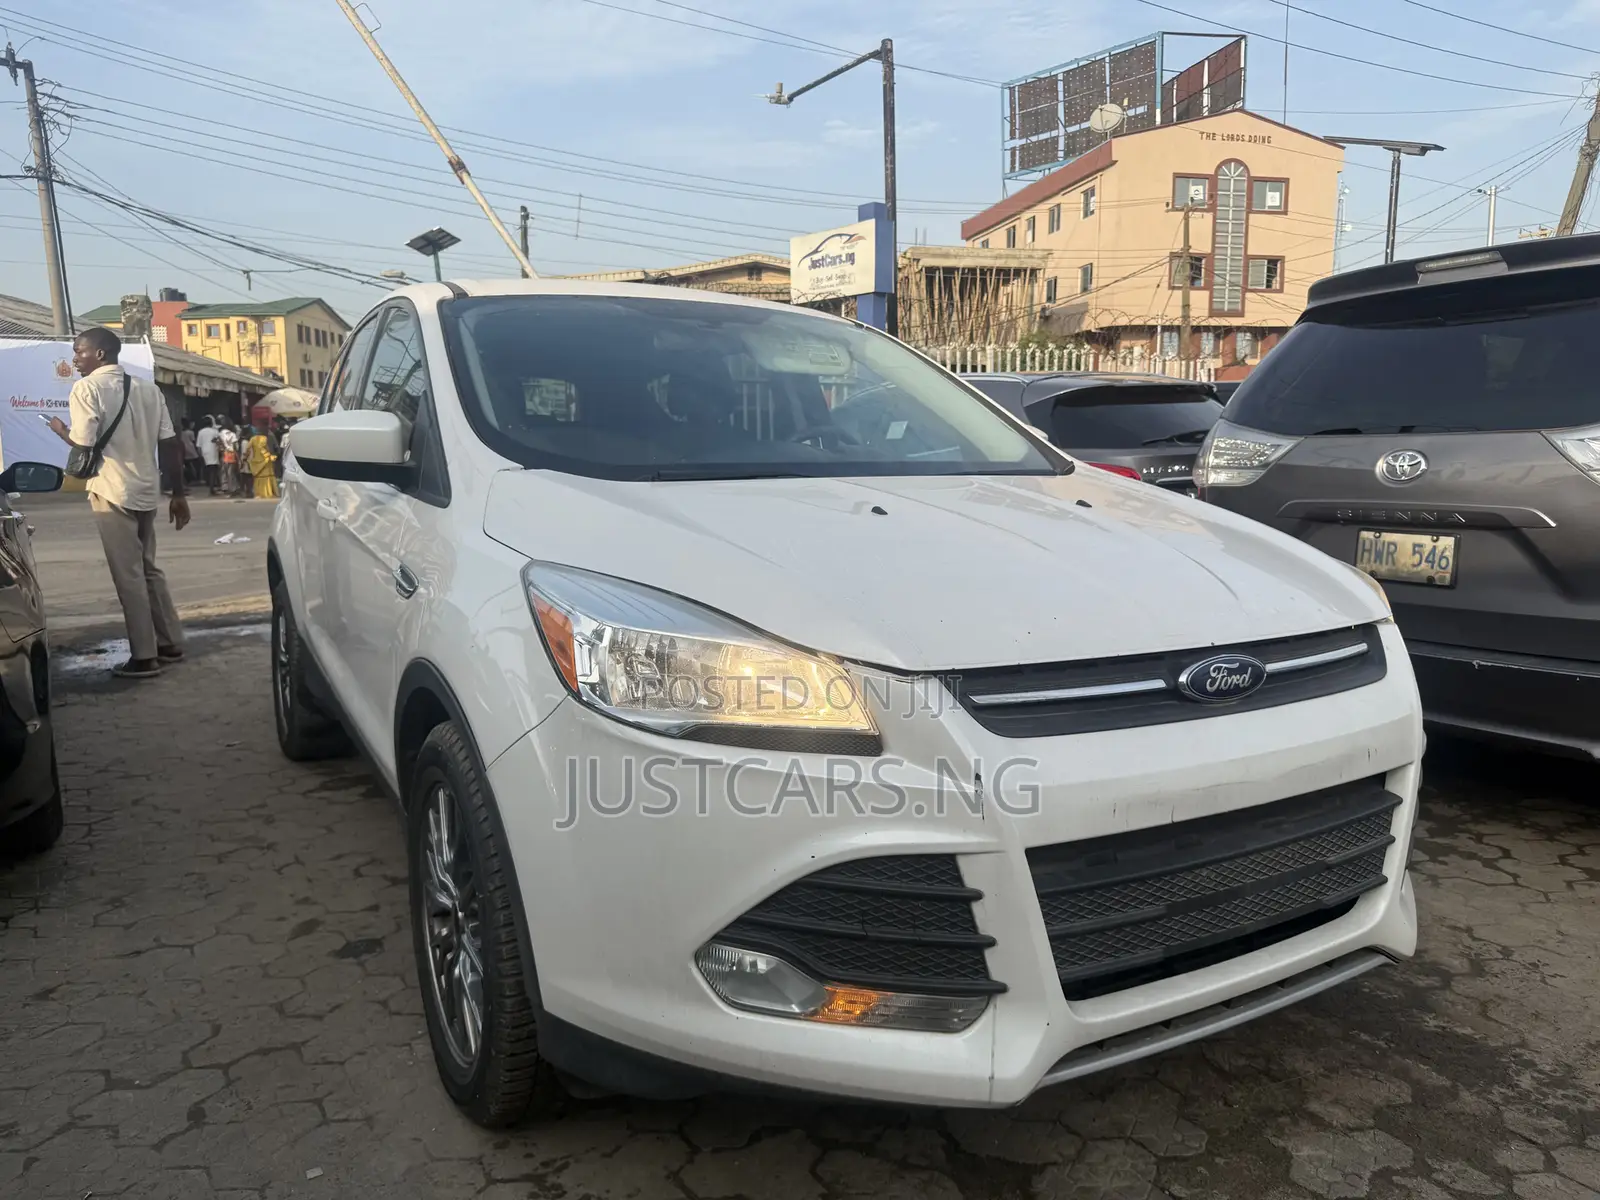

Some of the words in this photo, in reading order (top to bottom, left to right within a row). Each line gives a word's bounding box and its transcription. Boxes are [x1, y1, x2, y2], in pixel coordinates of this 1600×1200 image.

[1199, 131, 1217, 141] THE
[1248, 134, 1272, 145] DOING
[808, 252, 856, 270] JustCars.ng
[10, 395, 38, 408] Welcome
[1337, 509, 1466, 523] SIENNA
[1360, 539, 1398, 567] HWR
[1411, 542, 1451, 571] 546
[1206, 662, 1252, 692] Ford
